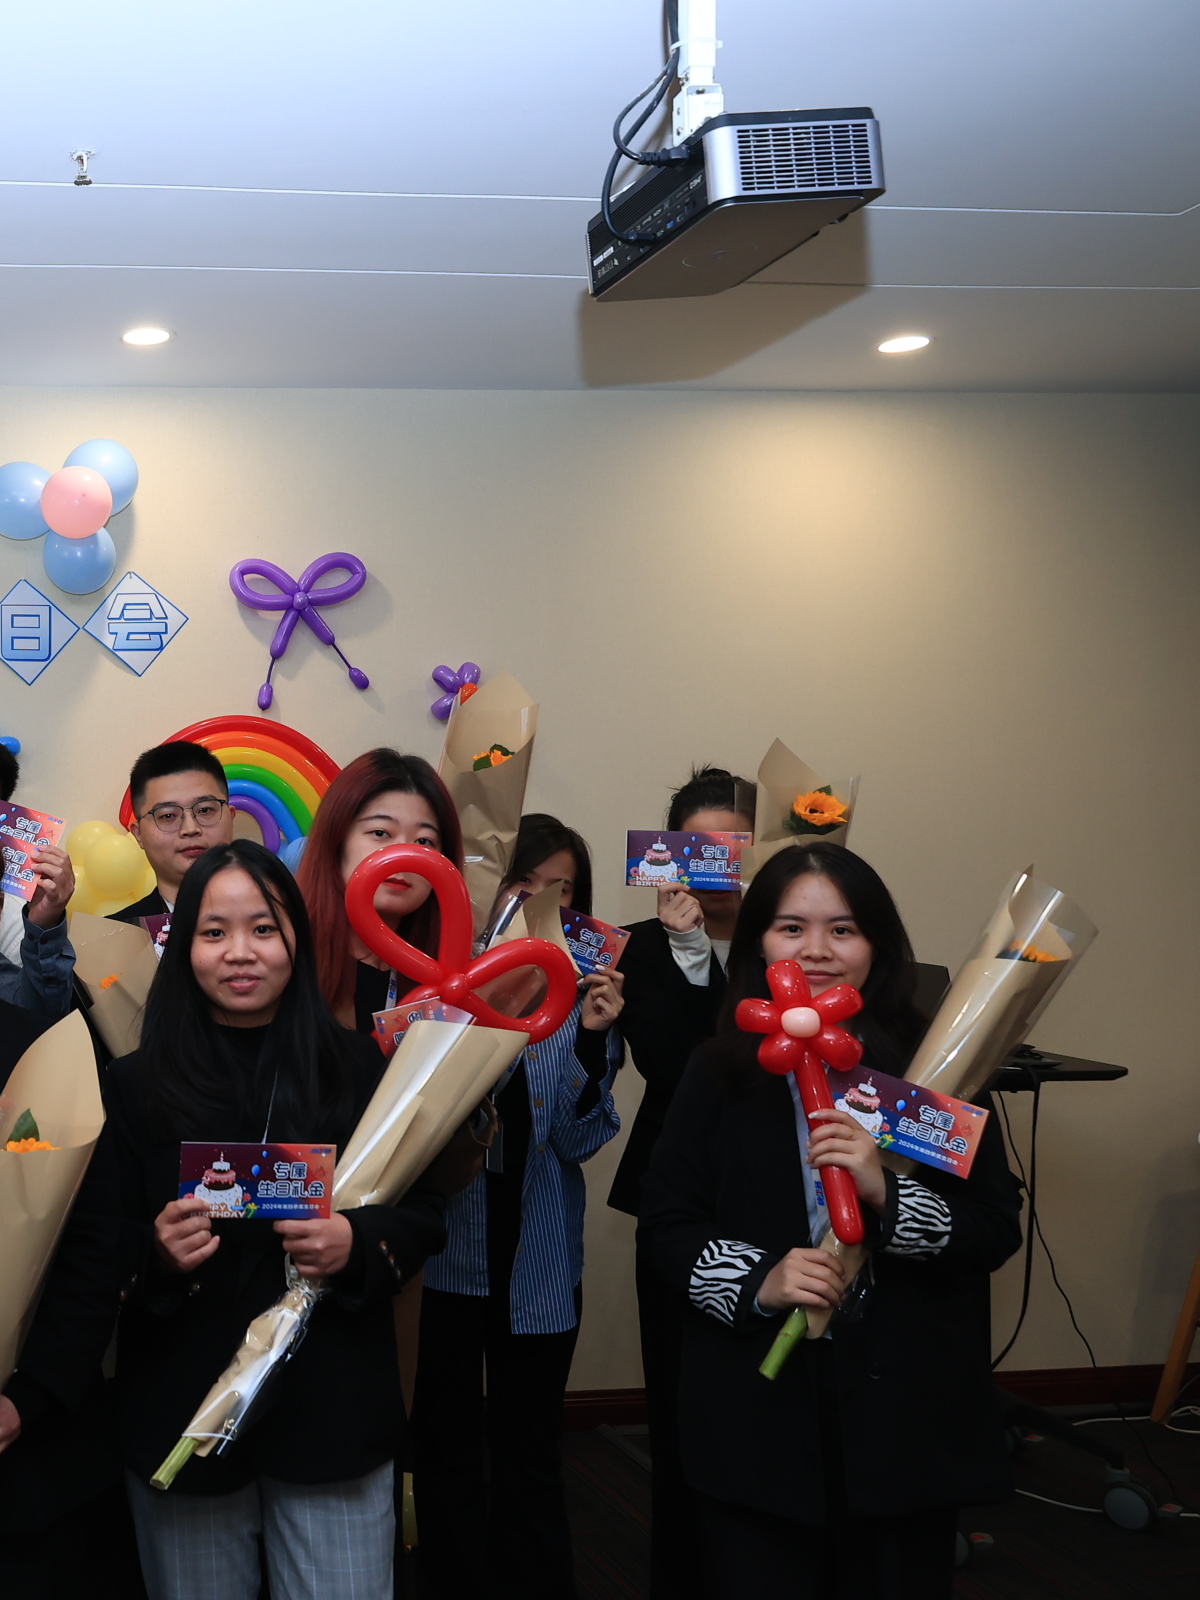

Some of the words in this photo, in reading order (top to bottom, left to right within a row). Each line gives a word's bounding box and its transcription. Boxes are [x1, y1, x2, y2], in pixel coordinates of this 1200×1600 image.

[15, 816, 43, 834] 专属
[701, 845, 729, 859] 专属
[579, 928, 606, 948] 专属
[918, 1105, 955, 1131] 专属
[896, 1117, 968, 1155] 生日礼金
[273, 1161, 308, 1180] 专属
[257, 1180, 325, 1198] 生日礼金
